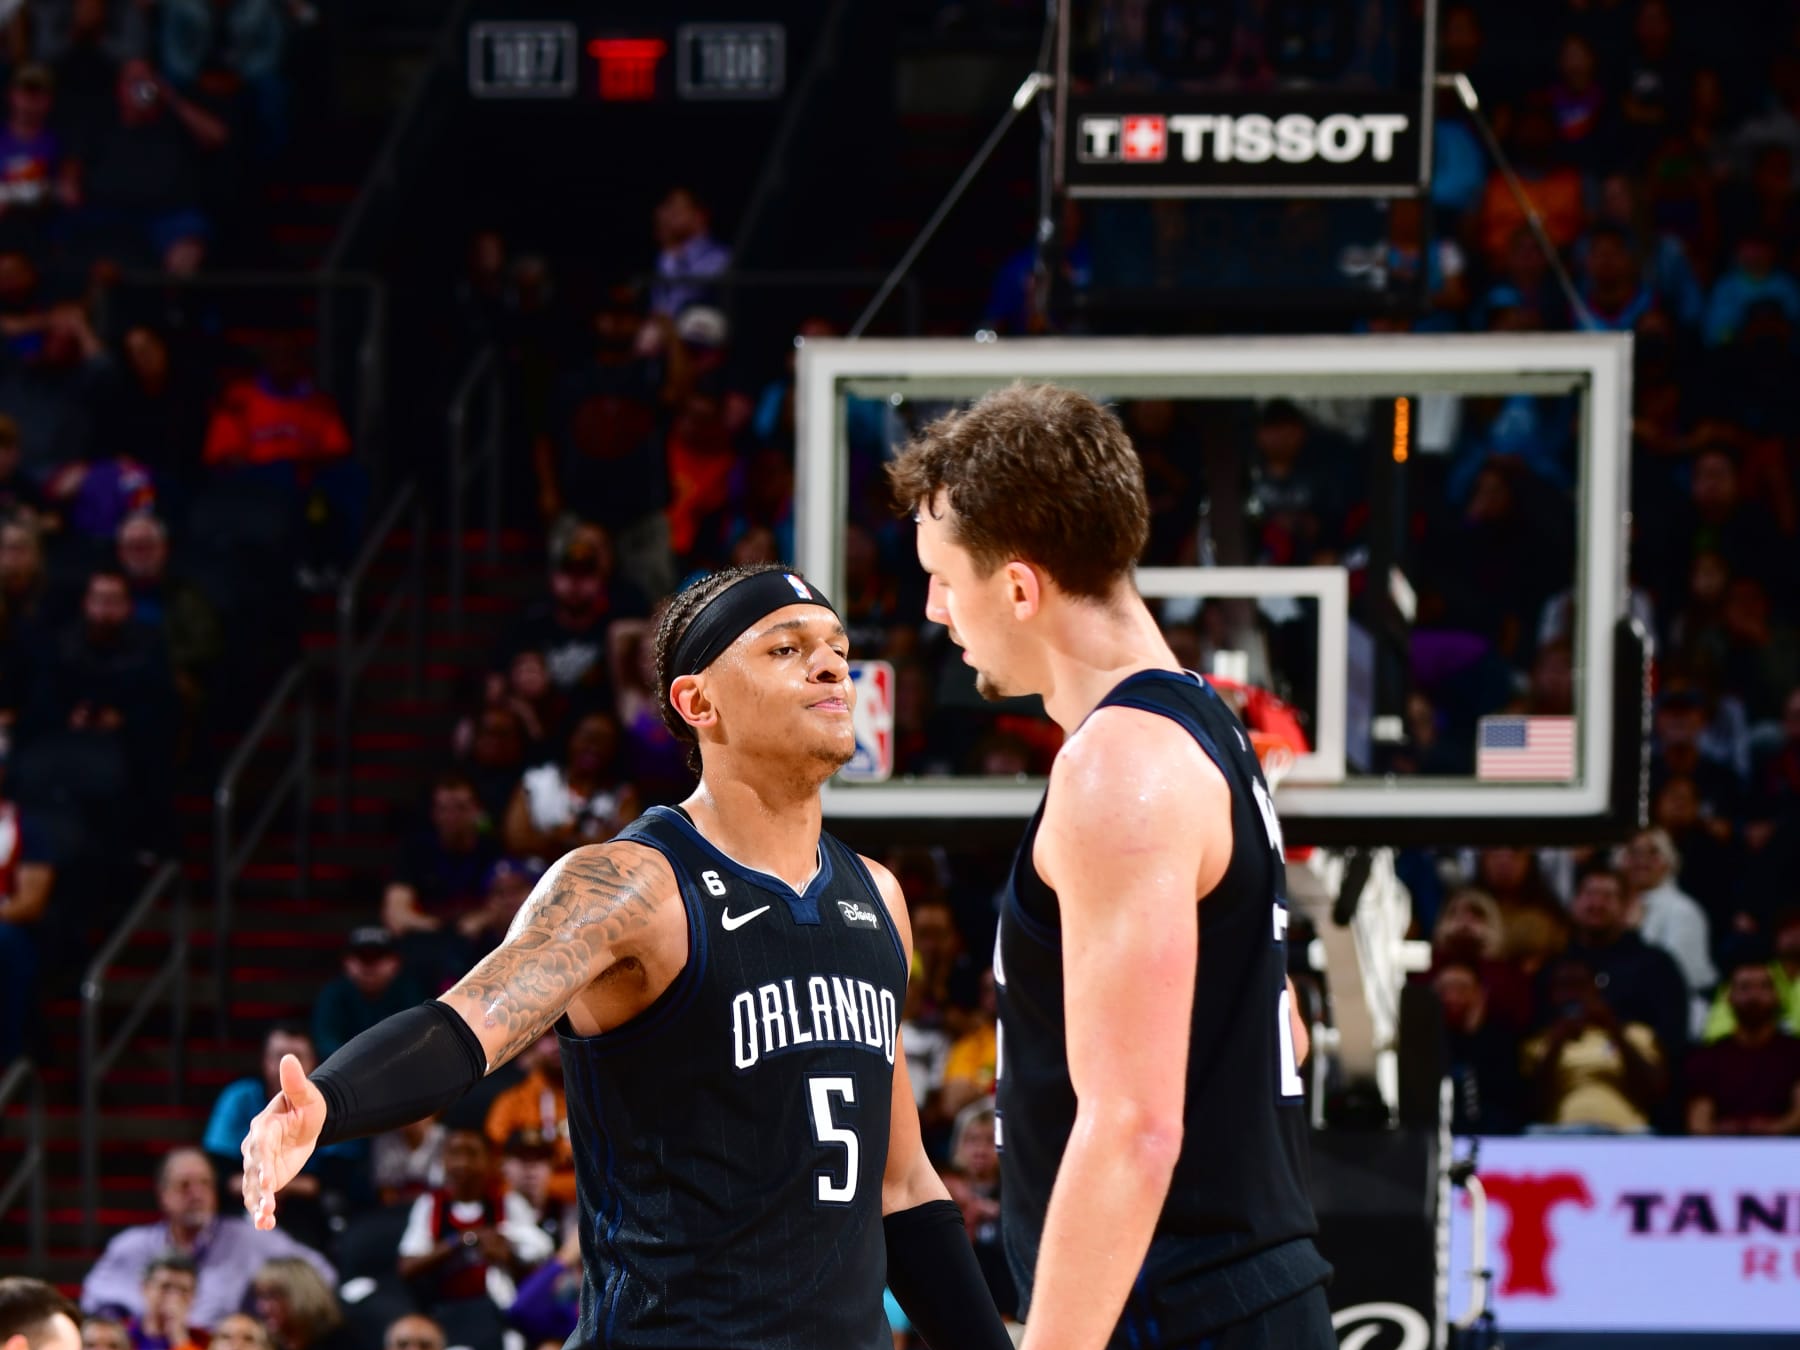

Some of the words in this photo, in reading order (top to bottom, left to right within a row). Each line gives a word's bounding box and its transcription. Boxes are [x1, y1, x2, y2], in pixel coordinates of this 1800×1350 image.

[1169, 114, 1408, 163] TISSOT
[702, 870, 727, 897] 6
[732, 976, 897, 1070] ORLANDO
[808, 1077, 860, 1202] 5
[1616, 1192, 1800, 1237] TAN
